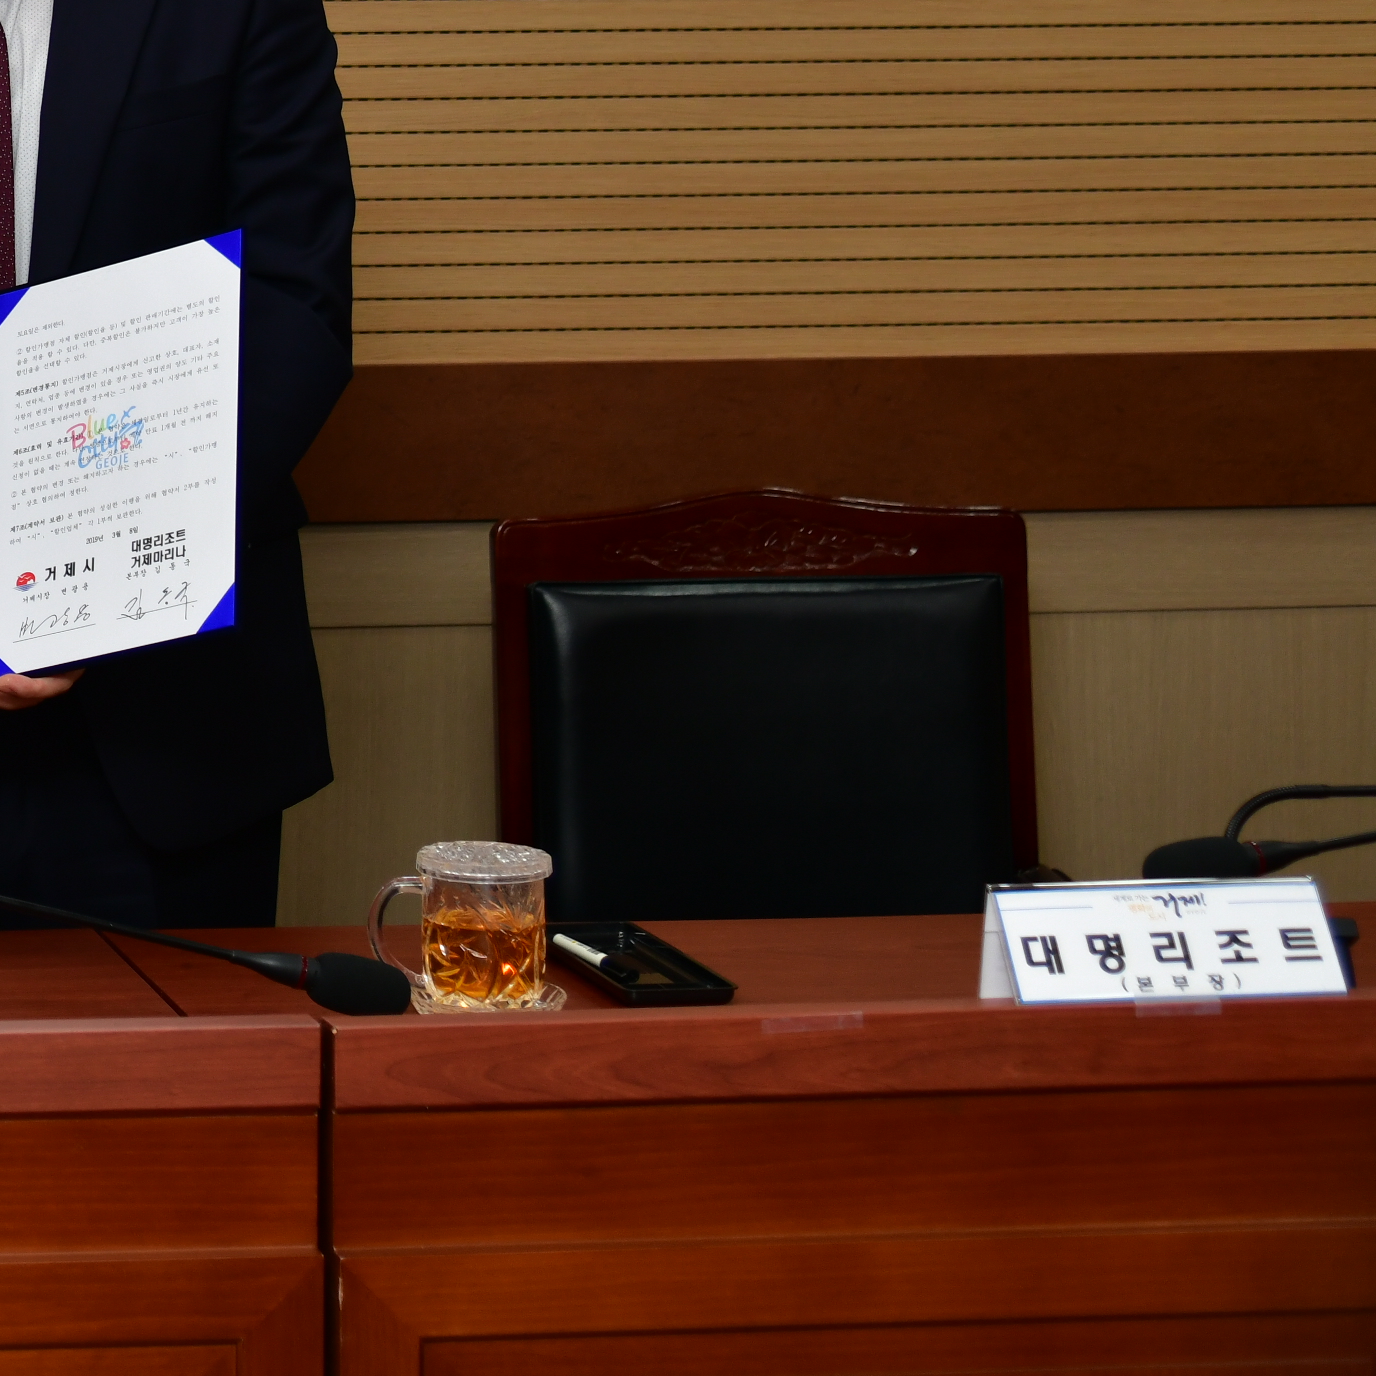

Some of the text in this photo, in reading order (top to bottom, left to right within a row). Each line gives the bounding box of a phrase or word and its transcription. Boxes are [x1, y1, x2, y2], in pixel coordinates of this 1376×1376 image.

[66, 415, 118, 449] Blue
[95, 453, 129, 470] GEOJE
[85, 525, 138, 544] 2019년 3월 8일
[131, 528, 185, 552] 대명리조트
[130, 544, 186, 568] 거제마리나
